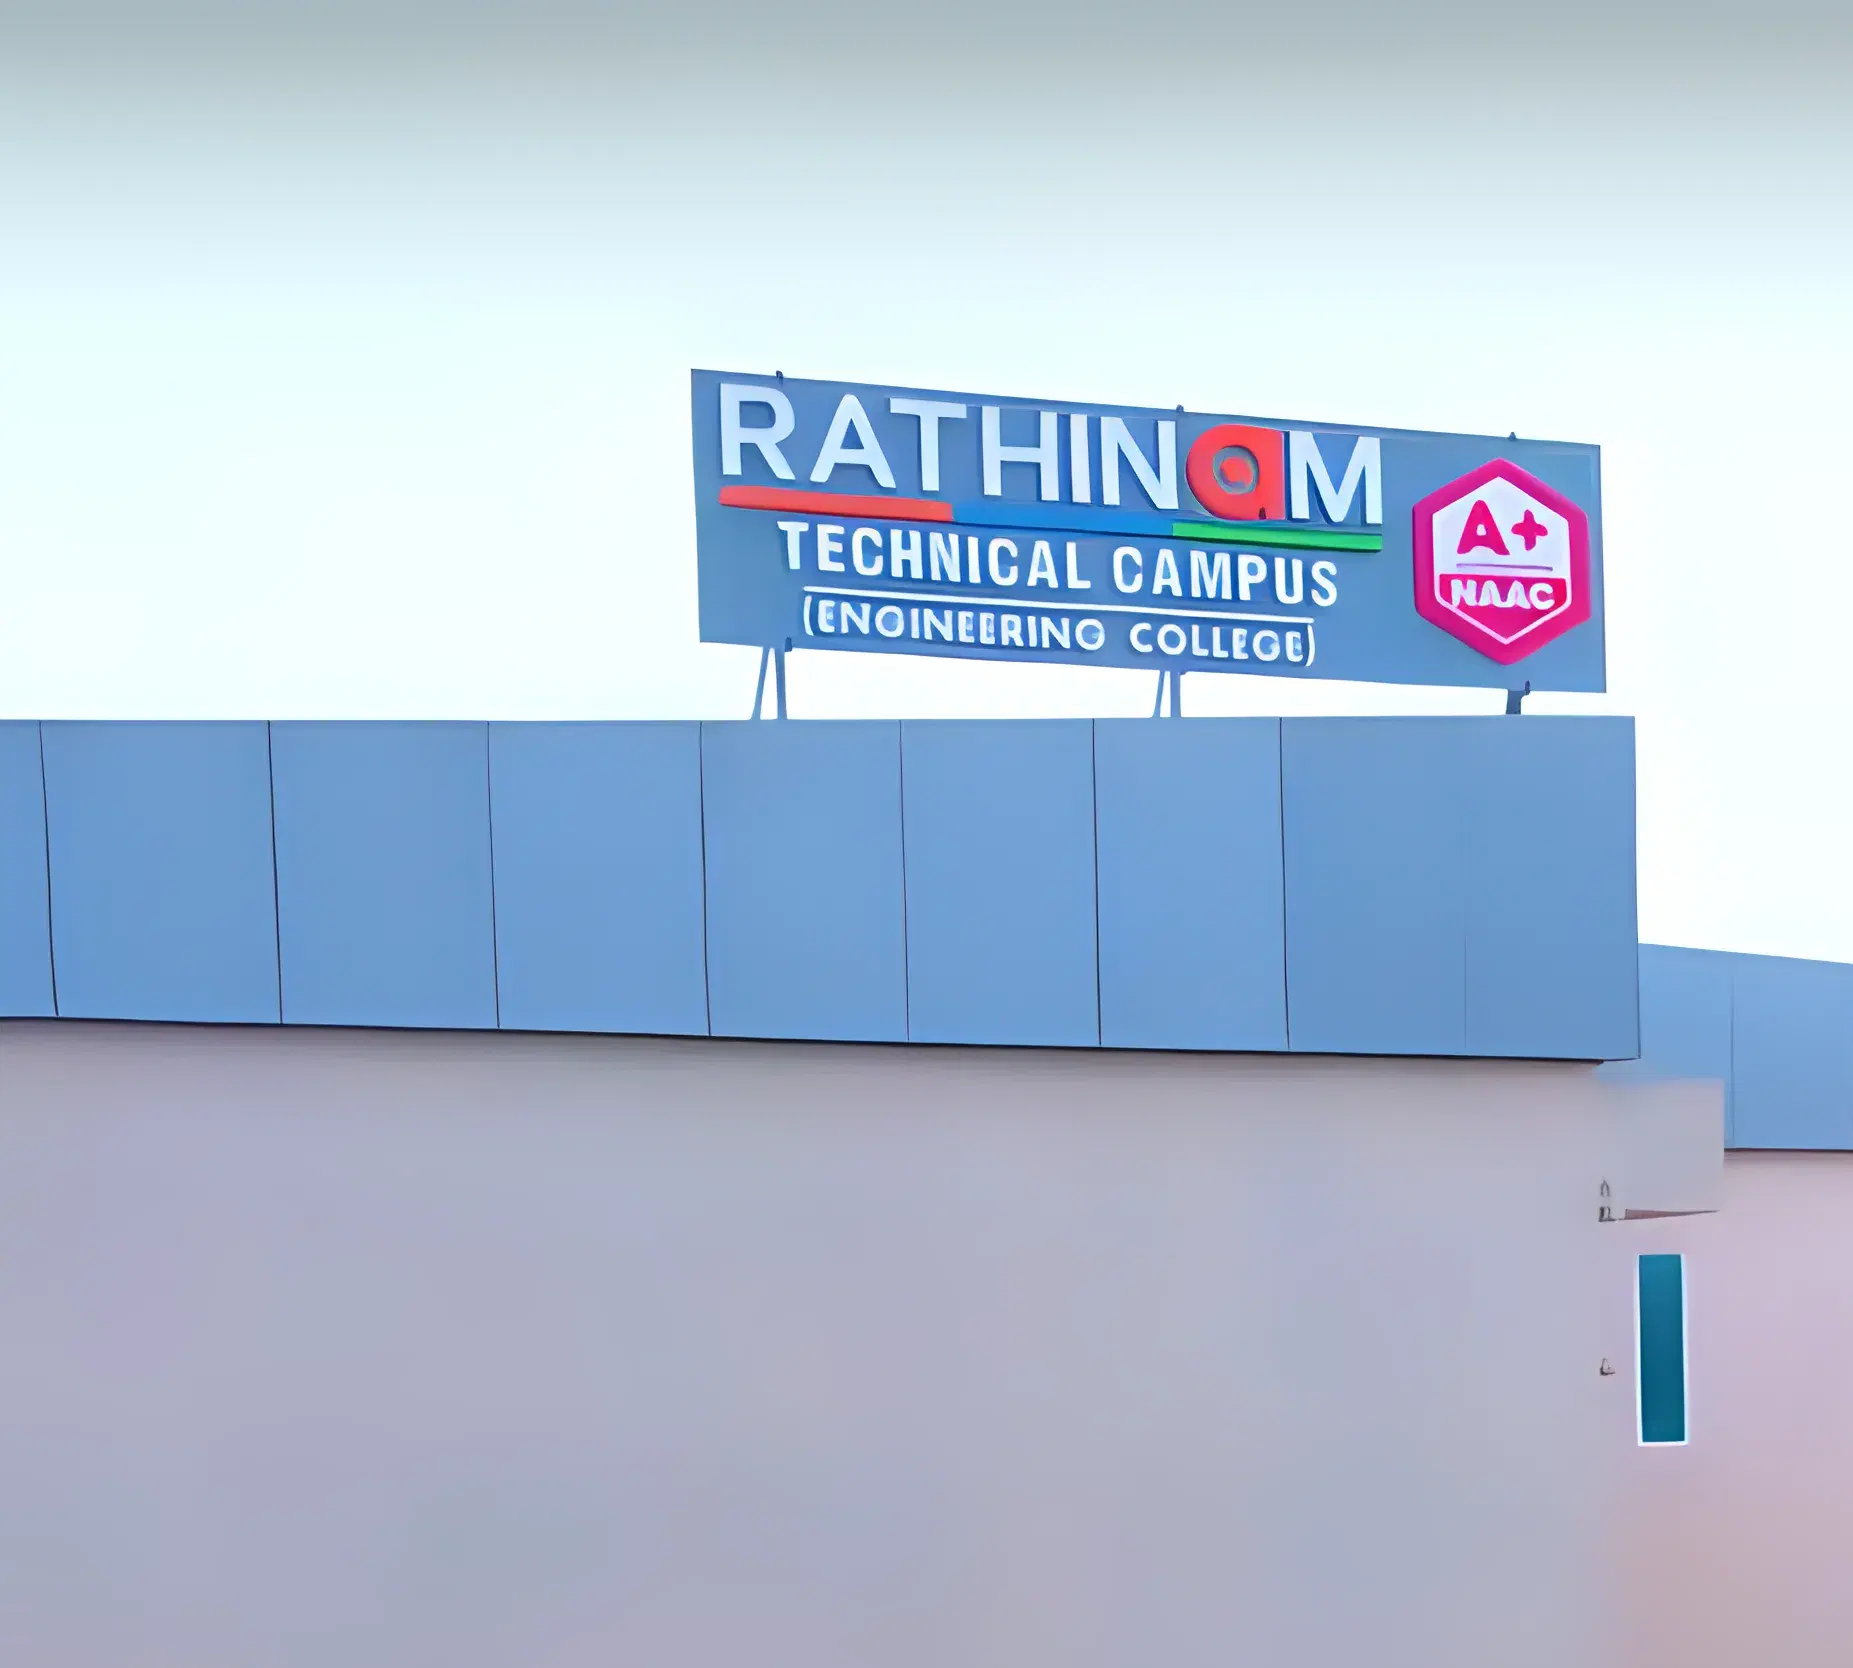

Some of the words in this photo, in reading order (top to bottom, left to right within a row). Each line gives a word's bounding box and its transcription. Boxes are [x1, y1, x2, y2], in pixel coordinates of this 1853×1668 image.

[1456, 499, 1549, 556] A+
[777, 520, 1092, 590] TECHNICAL
[1112, 546, 1338, 607] CAMPUS
[1450, 578, 1555, 610] NAAC
